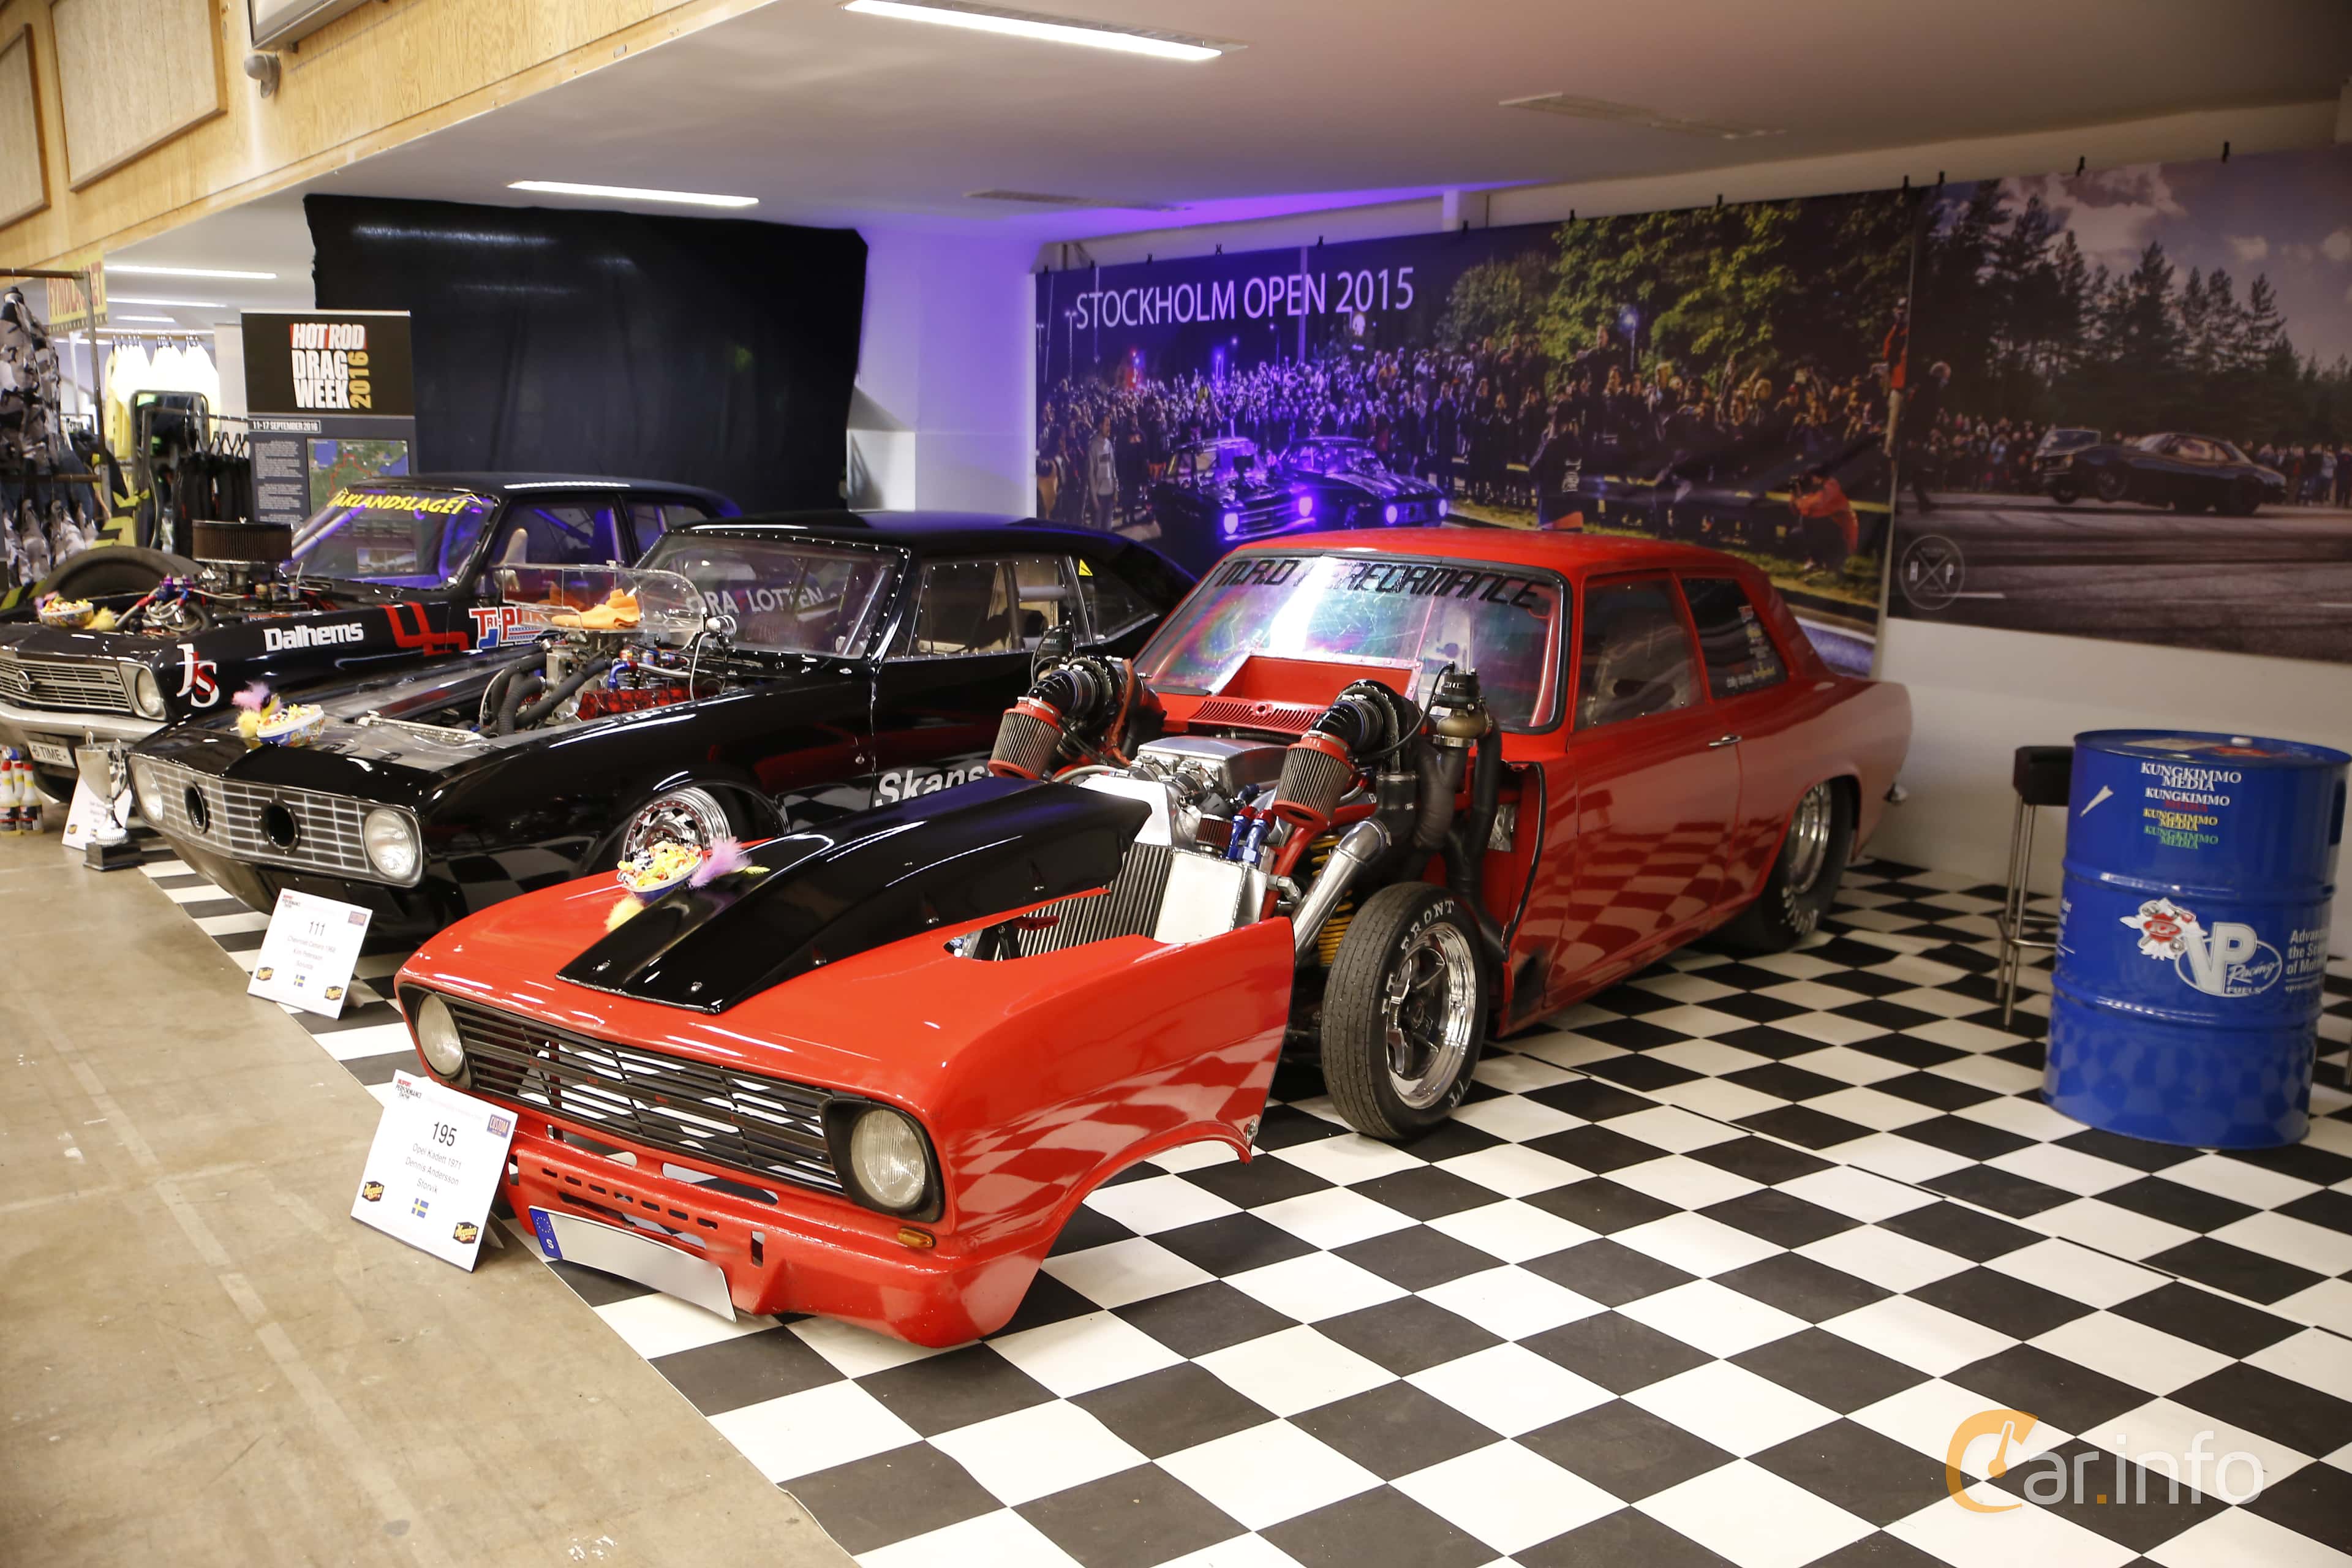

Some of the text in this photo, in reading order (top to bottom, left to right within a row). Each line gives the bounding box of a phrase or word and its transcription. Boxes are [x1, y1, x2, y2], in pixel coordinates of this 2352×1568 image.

[48, 260, 104, 317] FYNDLAET
[1076, 266, 1414, 330] STOCKHOLM OPEN 2015
[292, 323, 365, 350] HOT ROD
[292, 350, 349, 380] DRAG
[347, 350, 372, 409] 2016
[293, 379, 351, 409] WEEK
[270, 421, 303, 431] SEPTEMBER
[263, 622, 364, 652] Dalhems
[39, 746, 63, 761] TIME
[2140, 762, 2242, 783] KUNGKIMMO
[875, 766, 994, 807] Skans
[2161, 775, 2215, 791] MEDIA
[2145, 787, 2230, 806] KUNGKIMMO
[2143, 808, 2218, 826] KUNGKIMMO
[2160, 817, 2198, 831] MEDIA
[2144, 826, 2219, 845] KUNGKIMMO
[2160, 835, 2198, 850] MEDIA
[309, 921, 325, 936] 111
[2184, 922, 2258, 996] VP
[2288, 946, 2305, 960] the
[2226, 961, 2275, 986] Racing
[2286, 960, 2297, 974] of
[432, 1121, 457, 1147] 195
[489, 1116, 509, 1133] CUSTOM
[412, 1143, 462, 1169] Opel Kadett 1971
[405, 1156, 459, 1185] Dennis Andersson
[417, 1178, 437, 1194] Storvik
[546, 1238, 554, 1250] S
